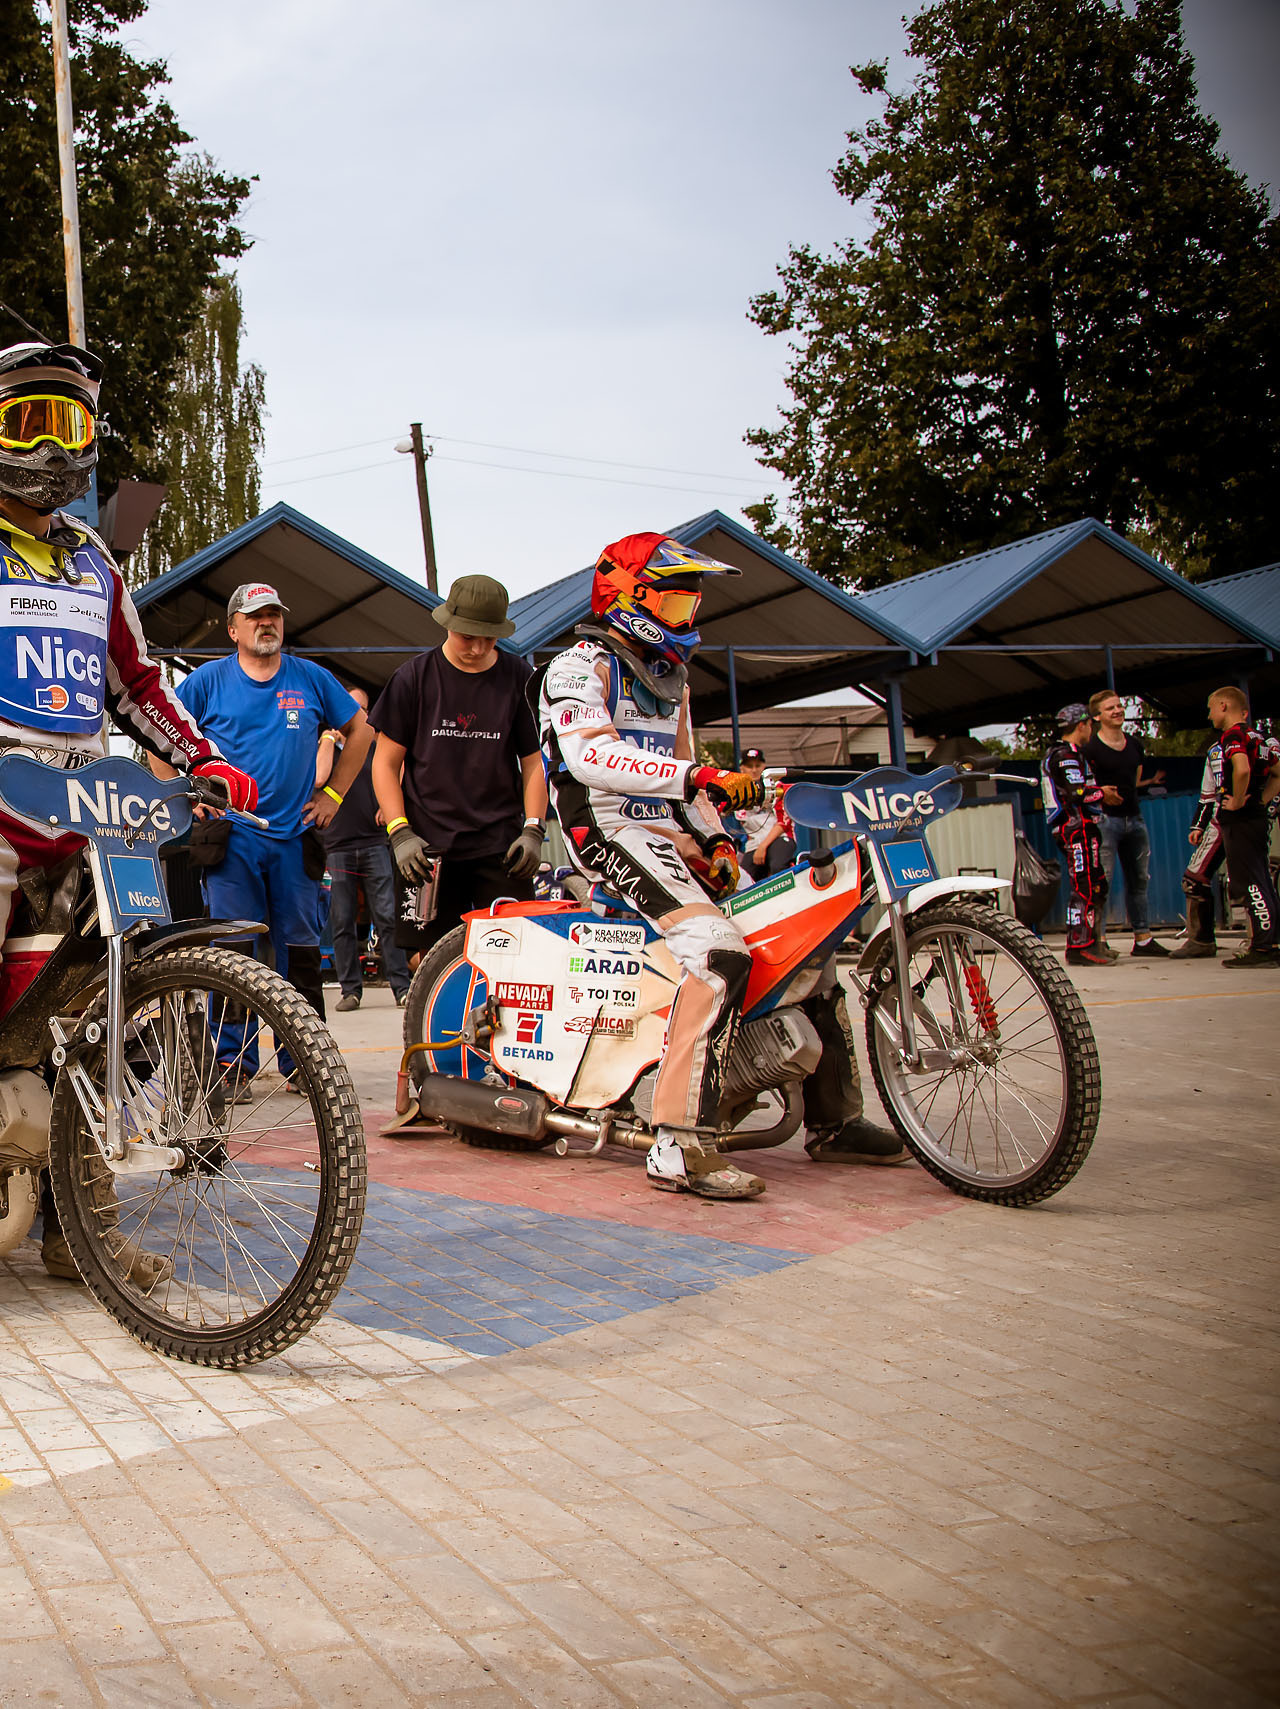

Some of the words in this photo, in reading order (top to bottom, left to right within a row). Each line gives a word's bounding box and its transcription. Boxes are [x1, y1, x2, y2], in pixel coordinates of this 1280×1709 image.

[10, 597, 57, 611] FIBARO
[68, 605, 91, 617] Deli
[93, 611, 106, 622] Tire
[16, 635, 102, 687] Nice
[66, 778, 171, 831] Nice
[841, 786, 935, 825] Nice
[868, 815, 924, 832] www.nice.pl
[901, 867, 930, 881] Nice
[127, 890, 161, 908] Nice
[732, 878, 793, 910] CHEMEKO-SYSTEM
[1247, 883, 1271, 932] adidas
[486, 937, 511, 948] PGE
[594, 929, 642, 940] KRAJEWSKI
[594, 936, 642, 945] KONSTRUKCJE
[583, 958, 641, 976] ARAD
[498, 983, 549, 1002] NEVADA
[587, 988, 609, 1001] TOI
[612, 989, 636, 1002] TOI
[519, 1001, 550, 1010] PARTS
[502, 1046, 554, 1062] BETARD
